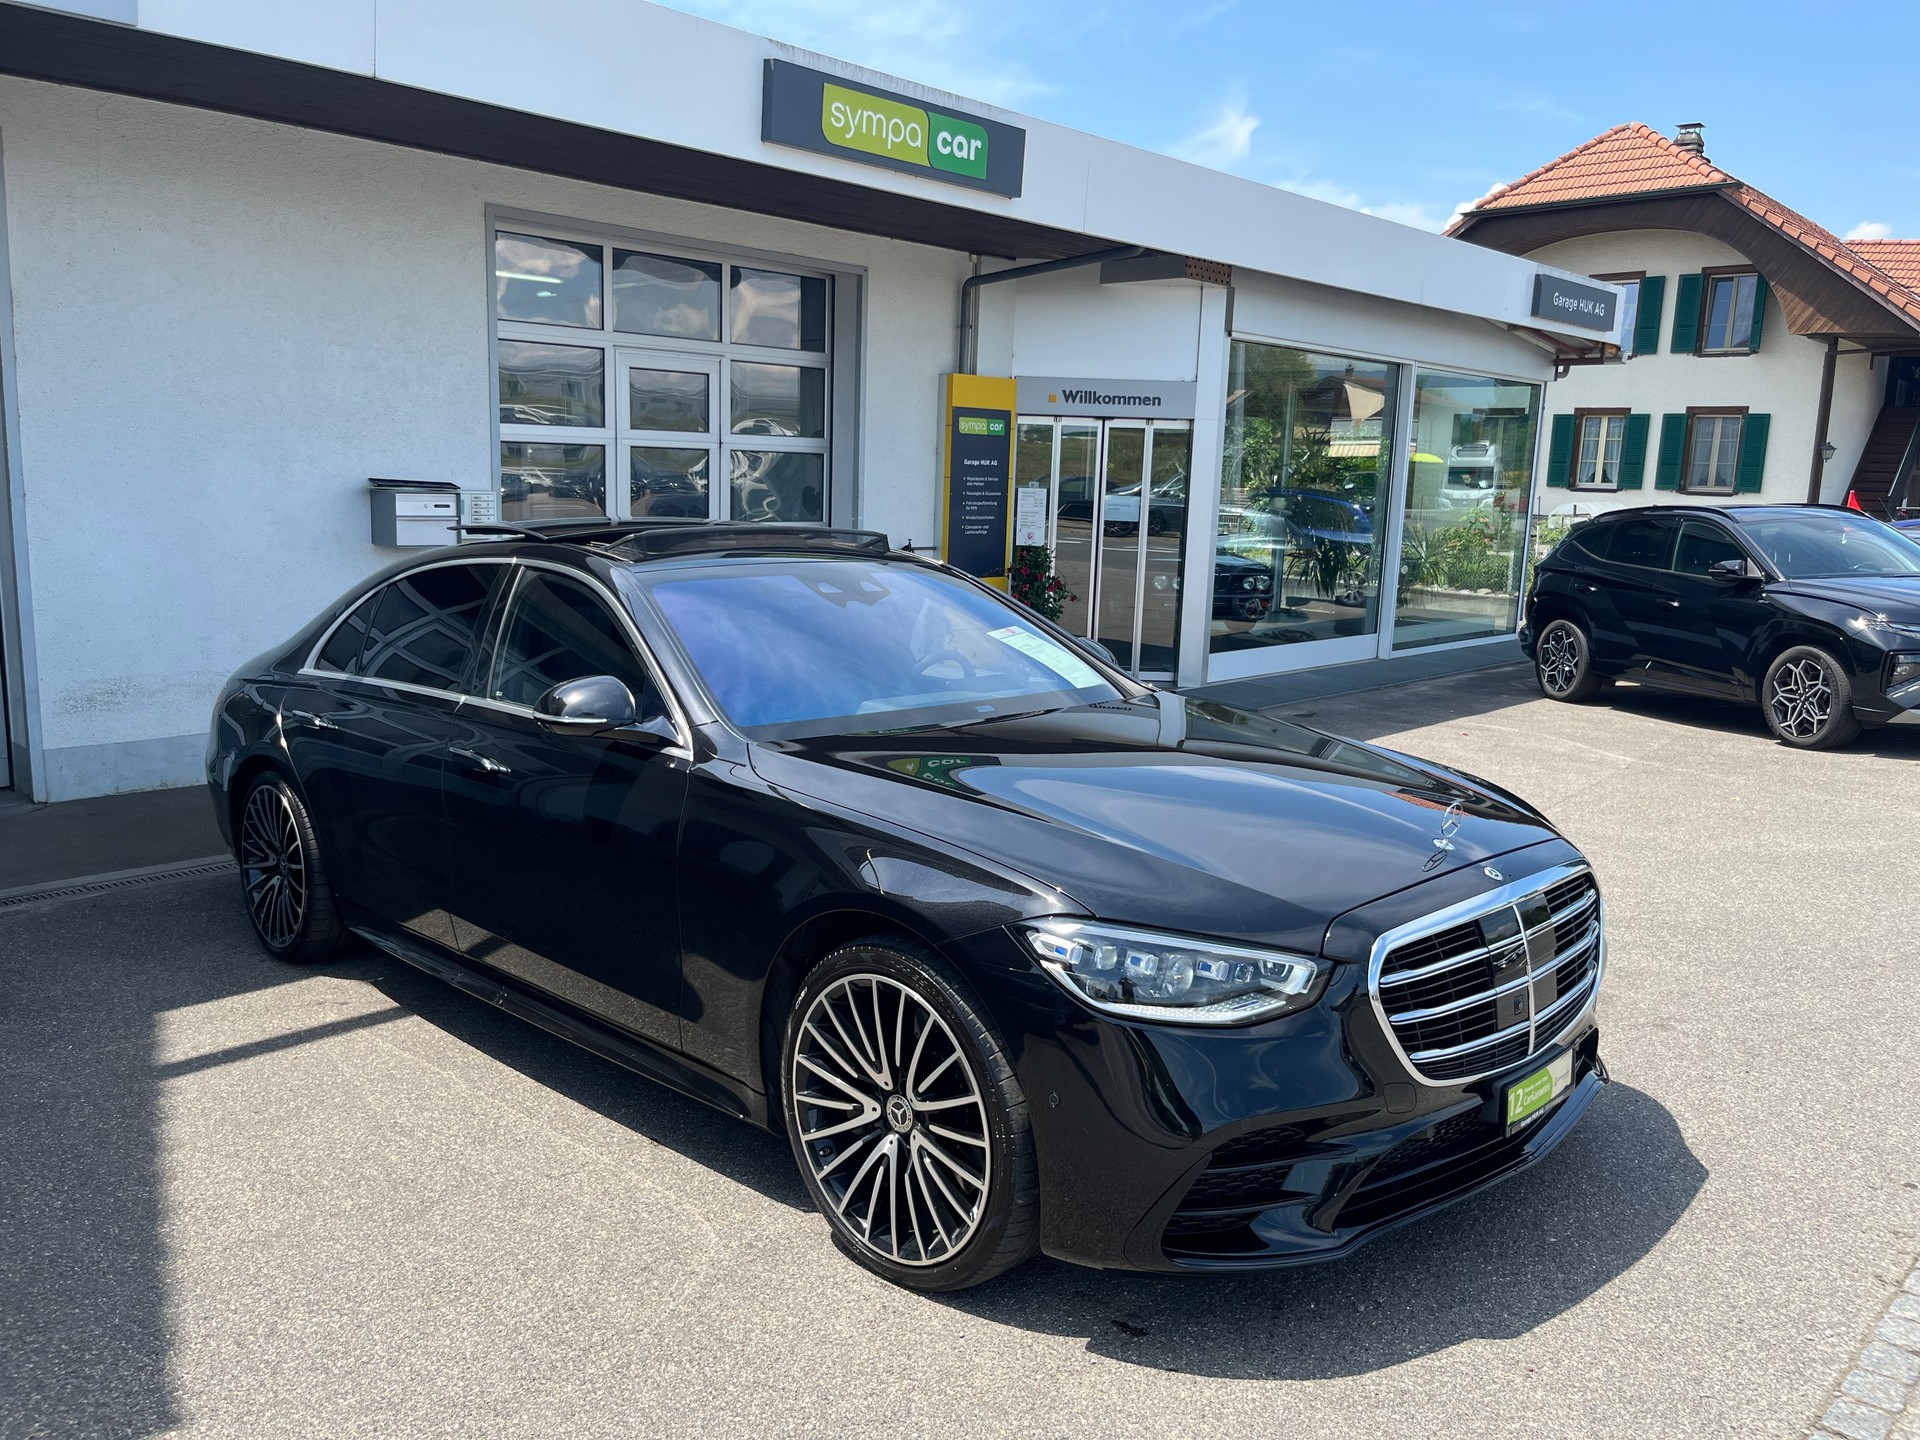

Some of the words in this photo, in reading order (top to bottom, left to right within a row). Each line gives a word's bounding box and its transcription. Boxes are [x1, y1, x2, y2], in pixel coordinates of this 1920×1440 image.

[830, 102, 922, 150] sympa
[936, 130, 982, 161] car
[1553, 292, 1578, 312] Garage
[1578, 298, 1594, 315] HUK
[1594, 303, 1605, 317] AG
[1062, 389, 1162, 407] Willkommen
[960, 421, 986, 432] sympa
[989, 423, 1003, 431] car
[1508, 1088, 1524, 1117] 12
